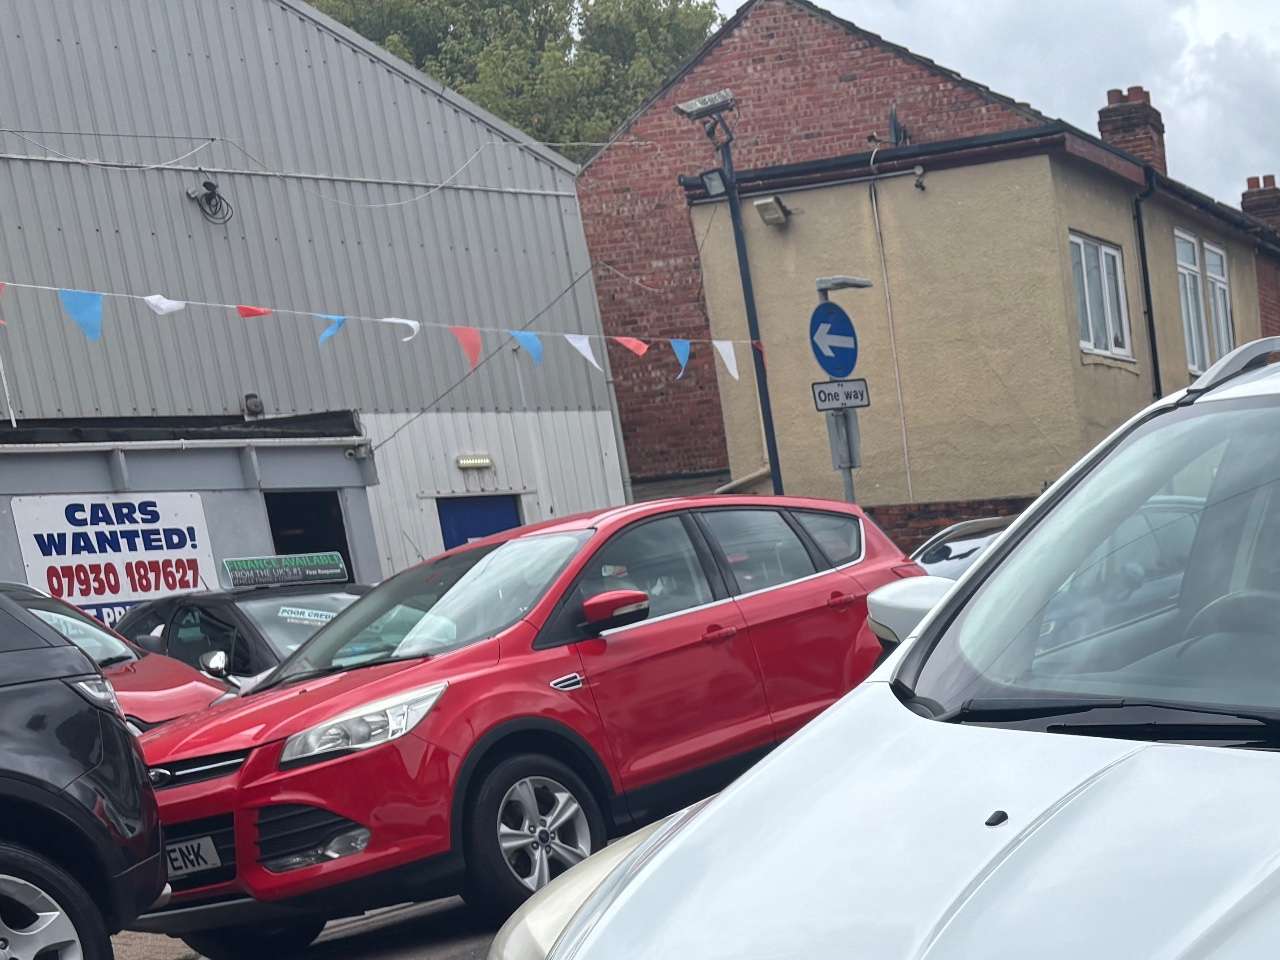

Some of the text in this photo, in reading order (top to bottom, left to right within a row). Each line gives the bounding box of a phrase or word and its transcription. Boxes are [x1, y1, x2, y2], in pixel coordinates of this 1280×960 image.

[818, 389, 864, 402] One way
[65, 501, 160, 527] CARS
[33, 526, 198, 557] WANTED!
[46, 558, 199, 599] 07930 187627
[168, 843, 208, 871] ENK
